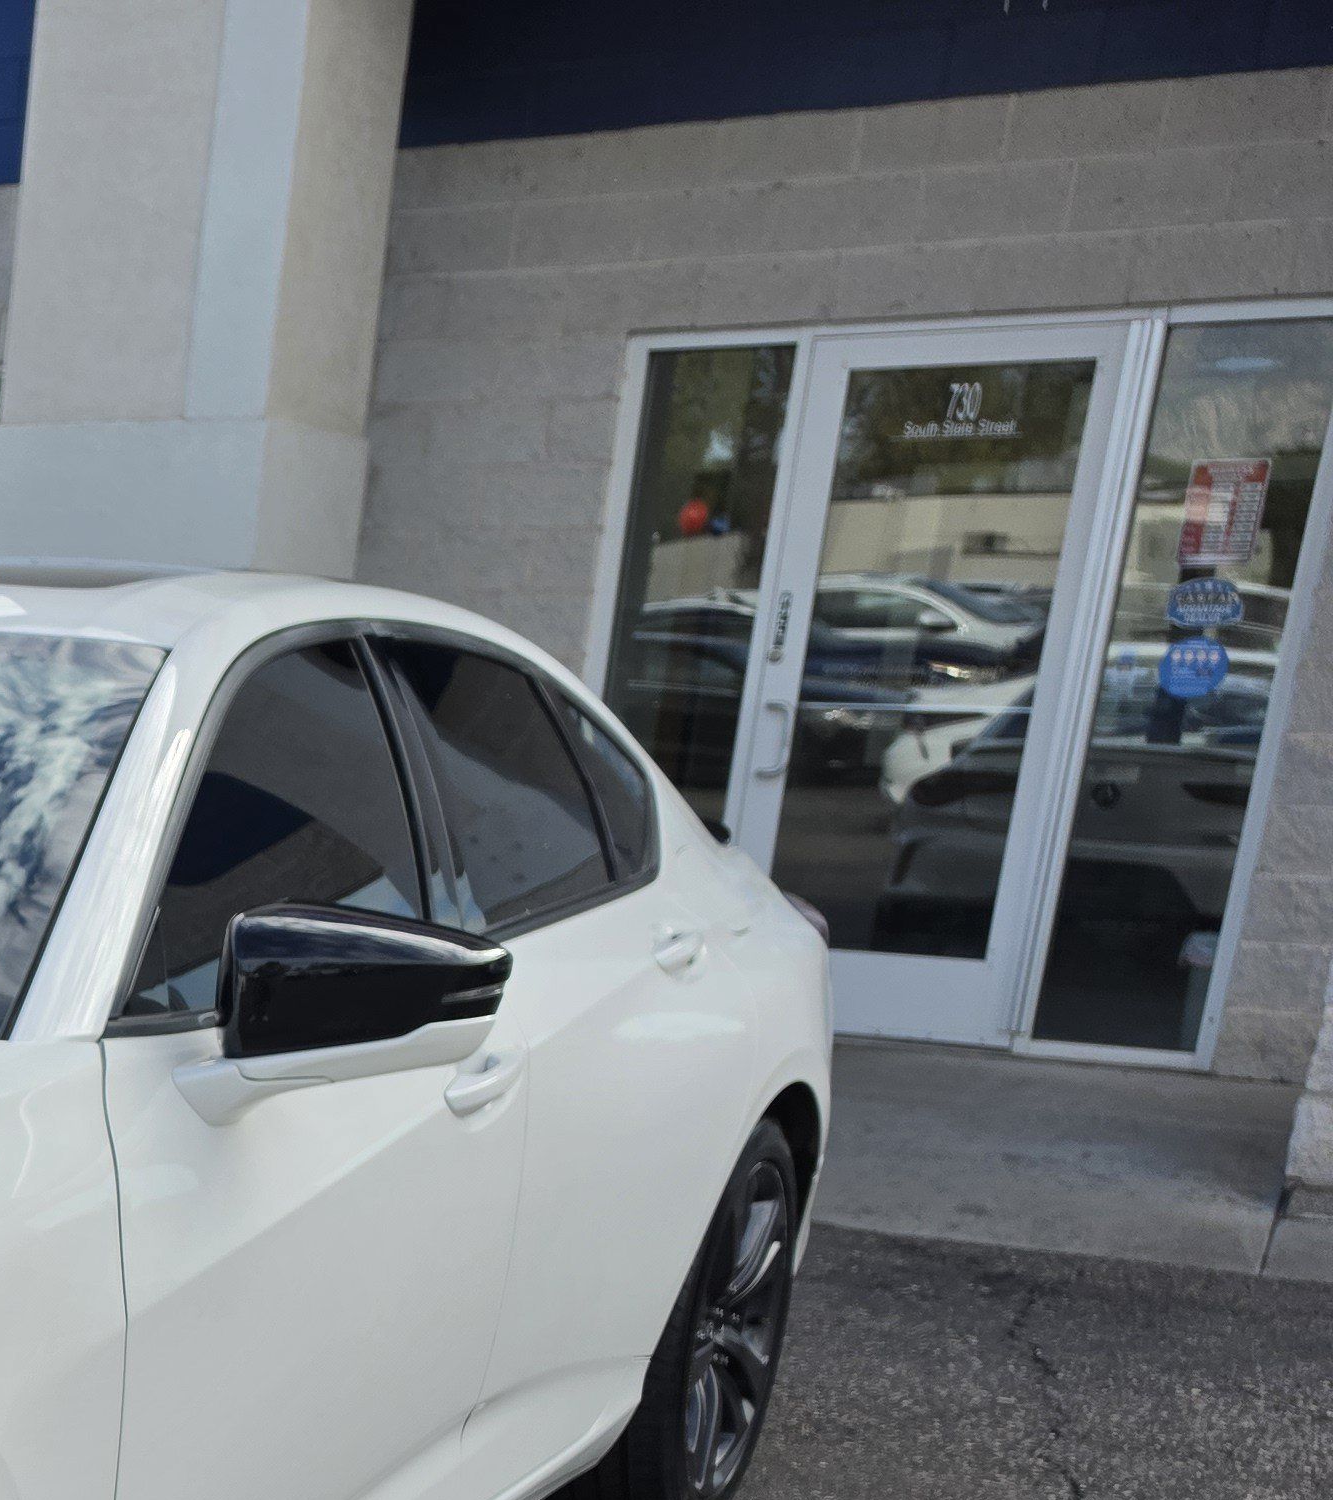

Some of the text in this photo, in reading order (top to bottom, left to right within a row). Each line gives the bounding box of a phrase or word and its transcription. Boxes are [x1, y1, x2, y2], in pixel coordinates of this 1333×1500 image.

[946, 382, 982, 420] 730
[903, 418, 1017, 438] South State Street
